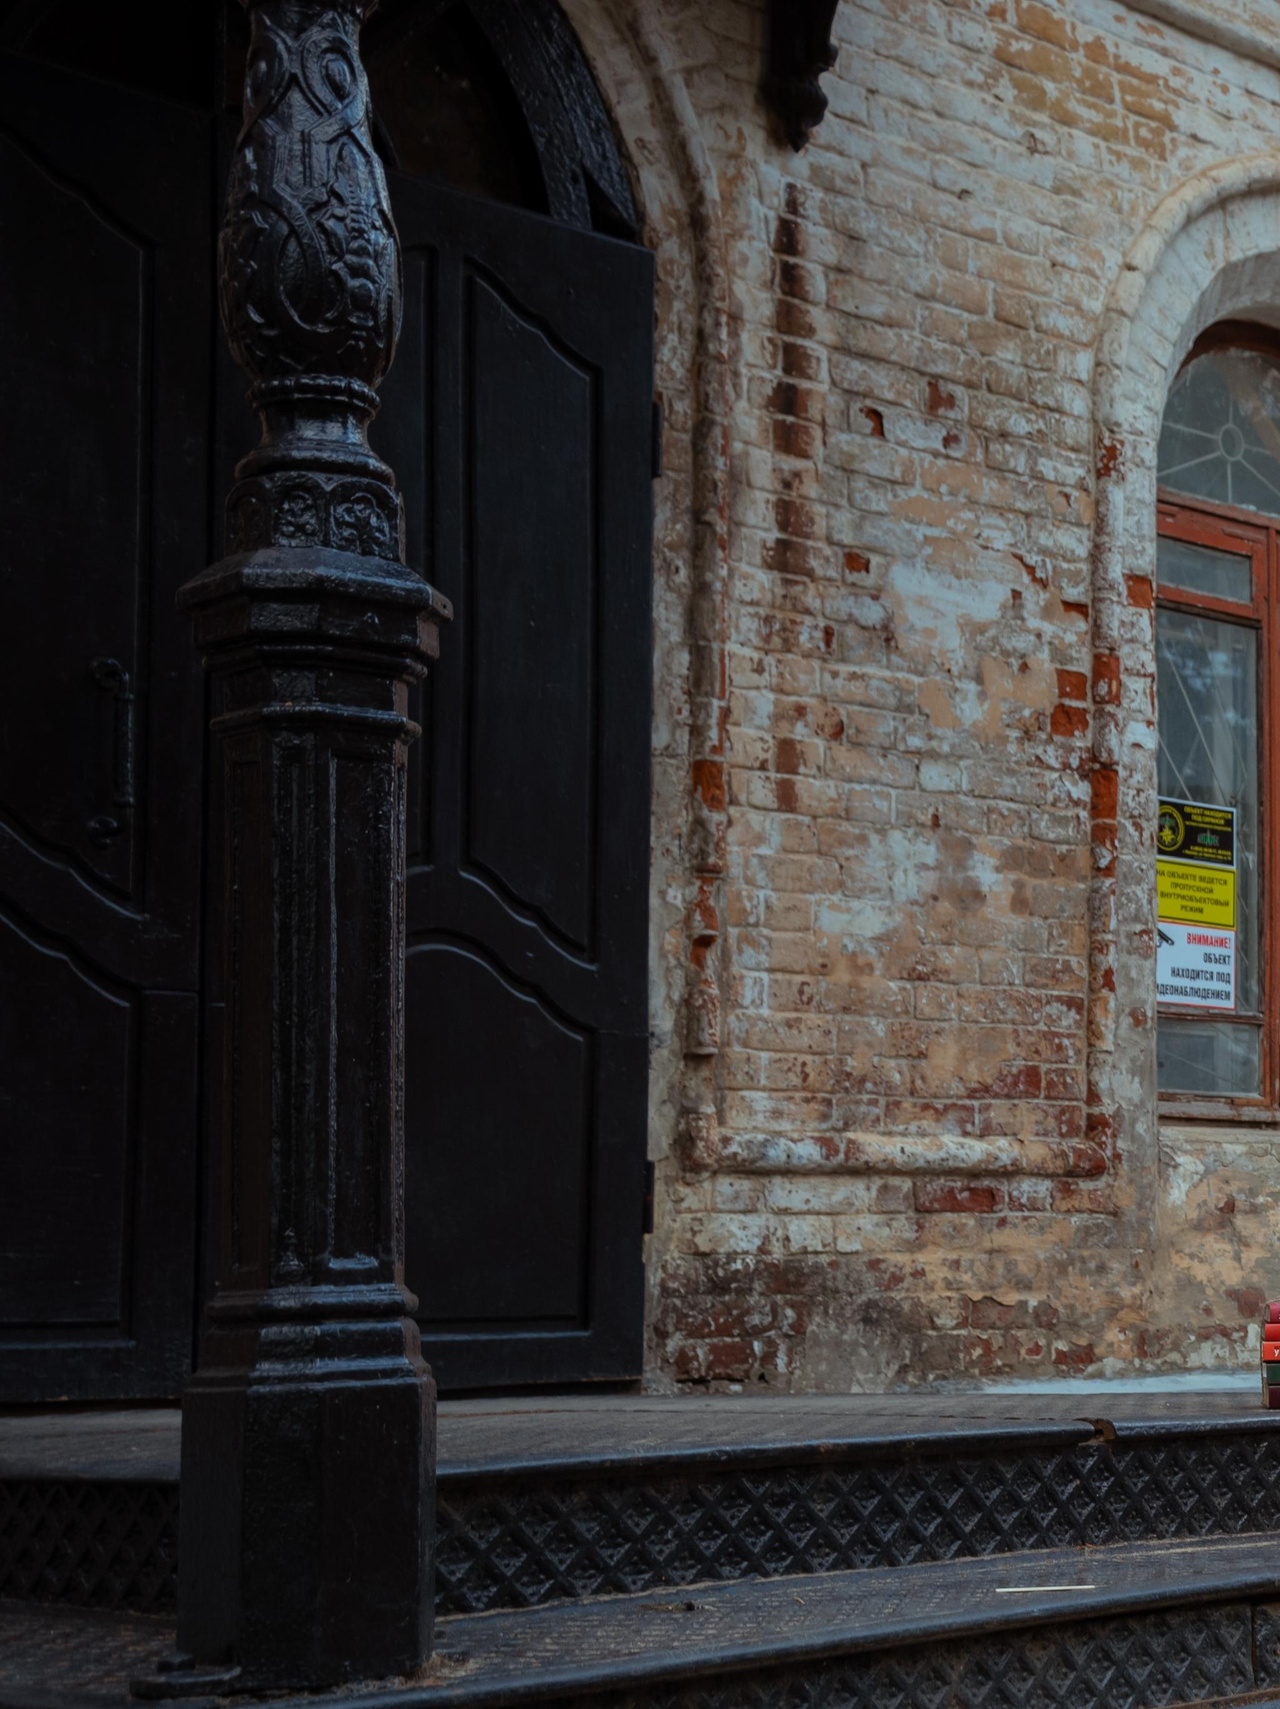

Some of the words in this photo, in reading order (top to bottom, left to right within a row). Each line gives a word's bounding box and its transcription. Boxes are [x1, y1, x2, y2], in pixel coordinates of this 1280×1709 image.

[1167, 870, 1197, 882] ОБЪЕКТЕ
[1199, 874, 1228, 886] ВЕДЕТСЯ
[1170, 881, 1214, 895] ПРОПУСКНОЙ
[1159, 890, 1230, 907] ВНУТРИОБЪЕКТОВЫЙ
[1180, 904, 1204, 914] РЕЖИМ
[1186, 932, 1231, 949] ВНИМАНИЕ!
[1203, 952, 1231, 966] ОБЪЕКТ
[1171, 966, 1214, 982] НАХОДИТСЯ
[1216, 971, 1231, 985] ПОД
